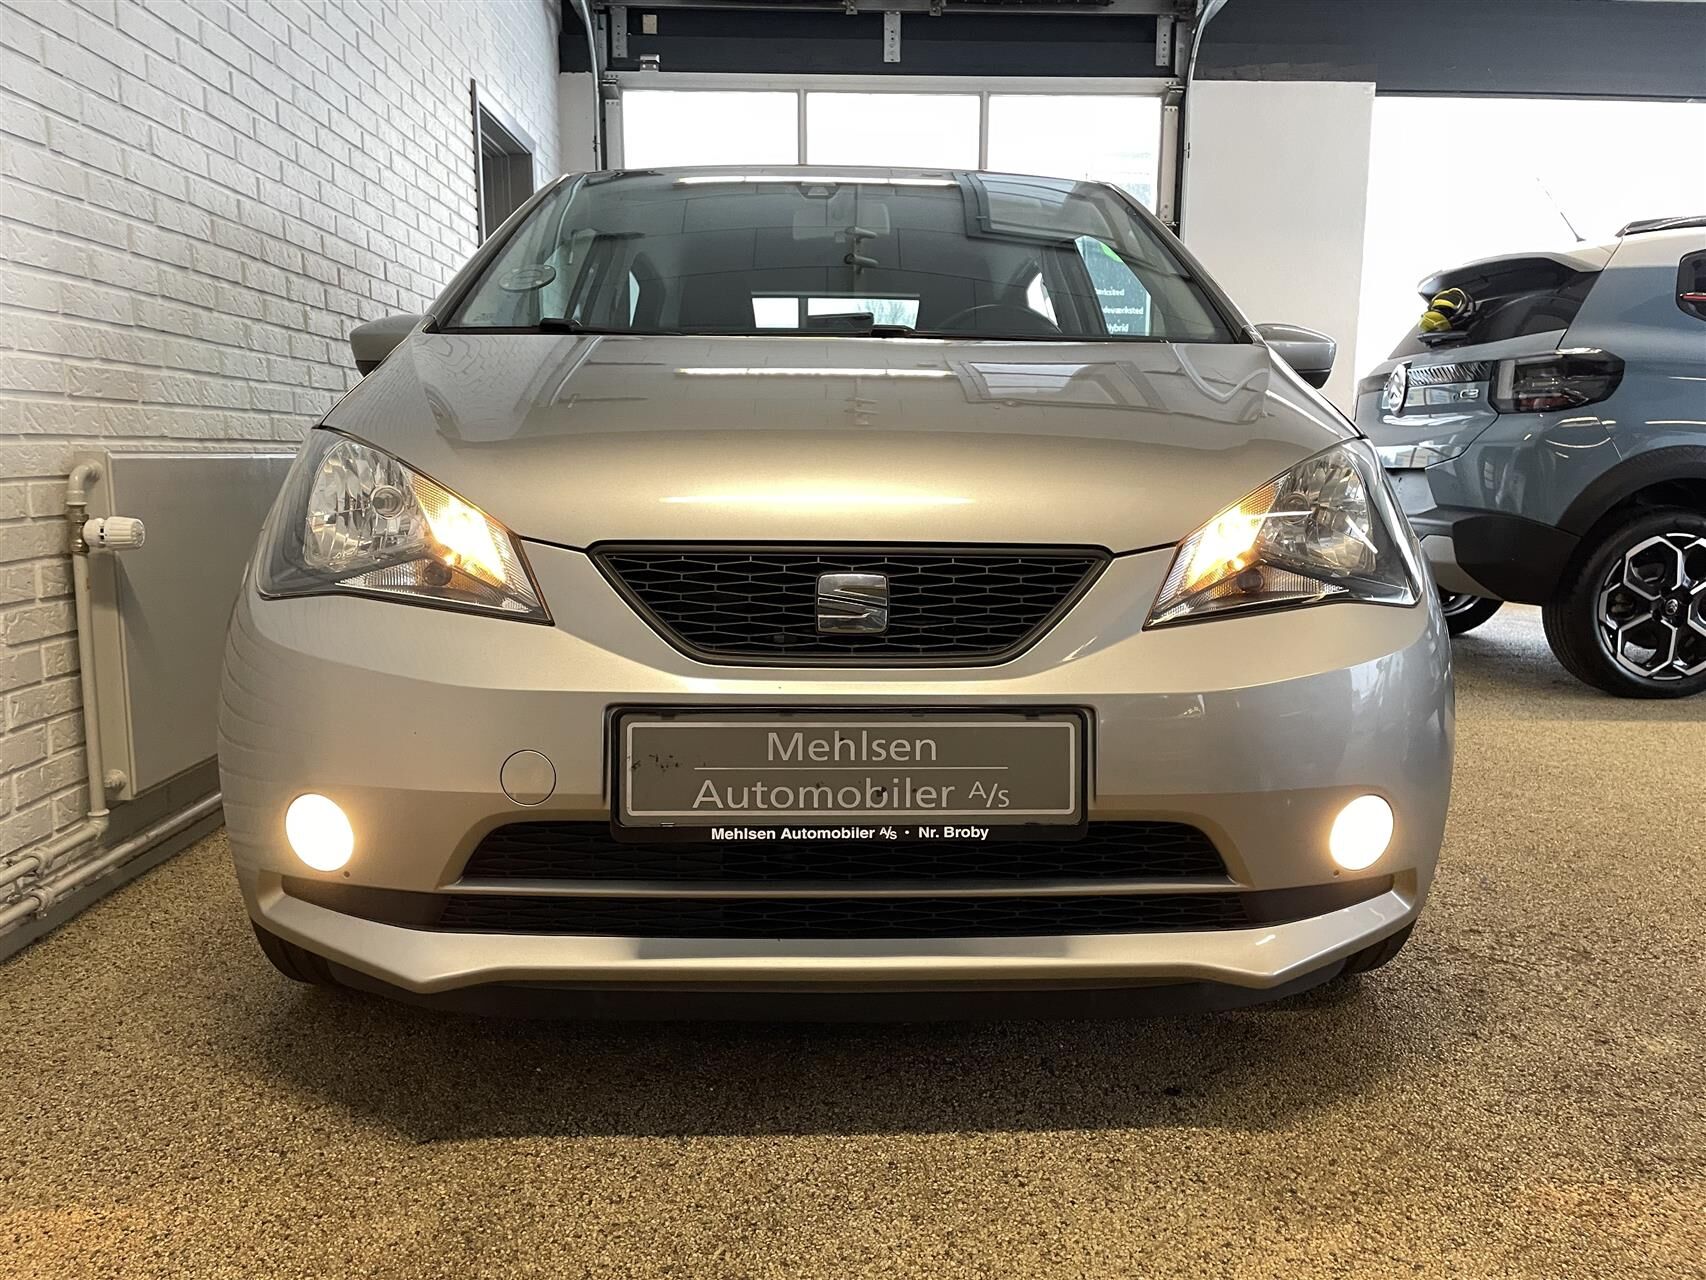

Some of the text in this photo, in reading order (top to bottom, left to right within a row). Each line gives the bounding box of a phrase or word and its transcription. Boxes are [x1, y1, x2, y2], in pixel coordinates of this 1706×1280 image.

[767, 730, 937, 762] Mehlsen
[692, 777, 956, 809] Automobiler
[711, 827, 776, 840] Mehlsen
[780, 826, 875, 840] Automobiler
[918, 826, 939, 838] Nr.
[943, 825, 989, 841] Broby
